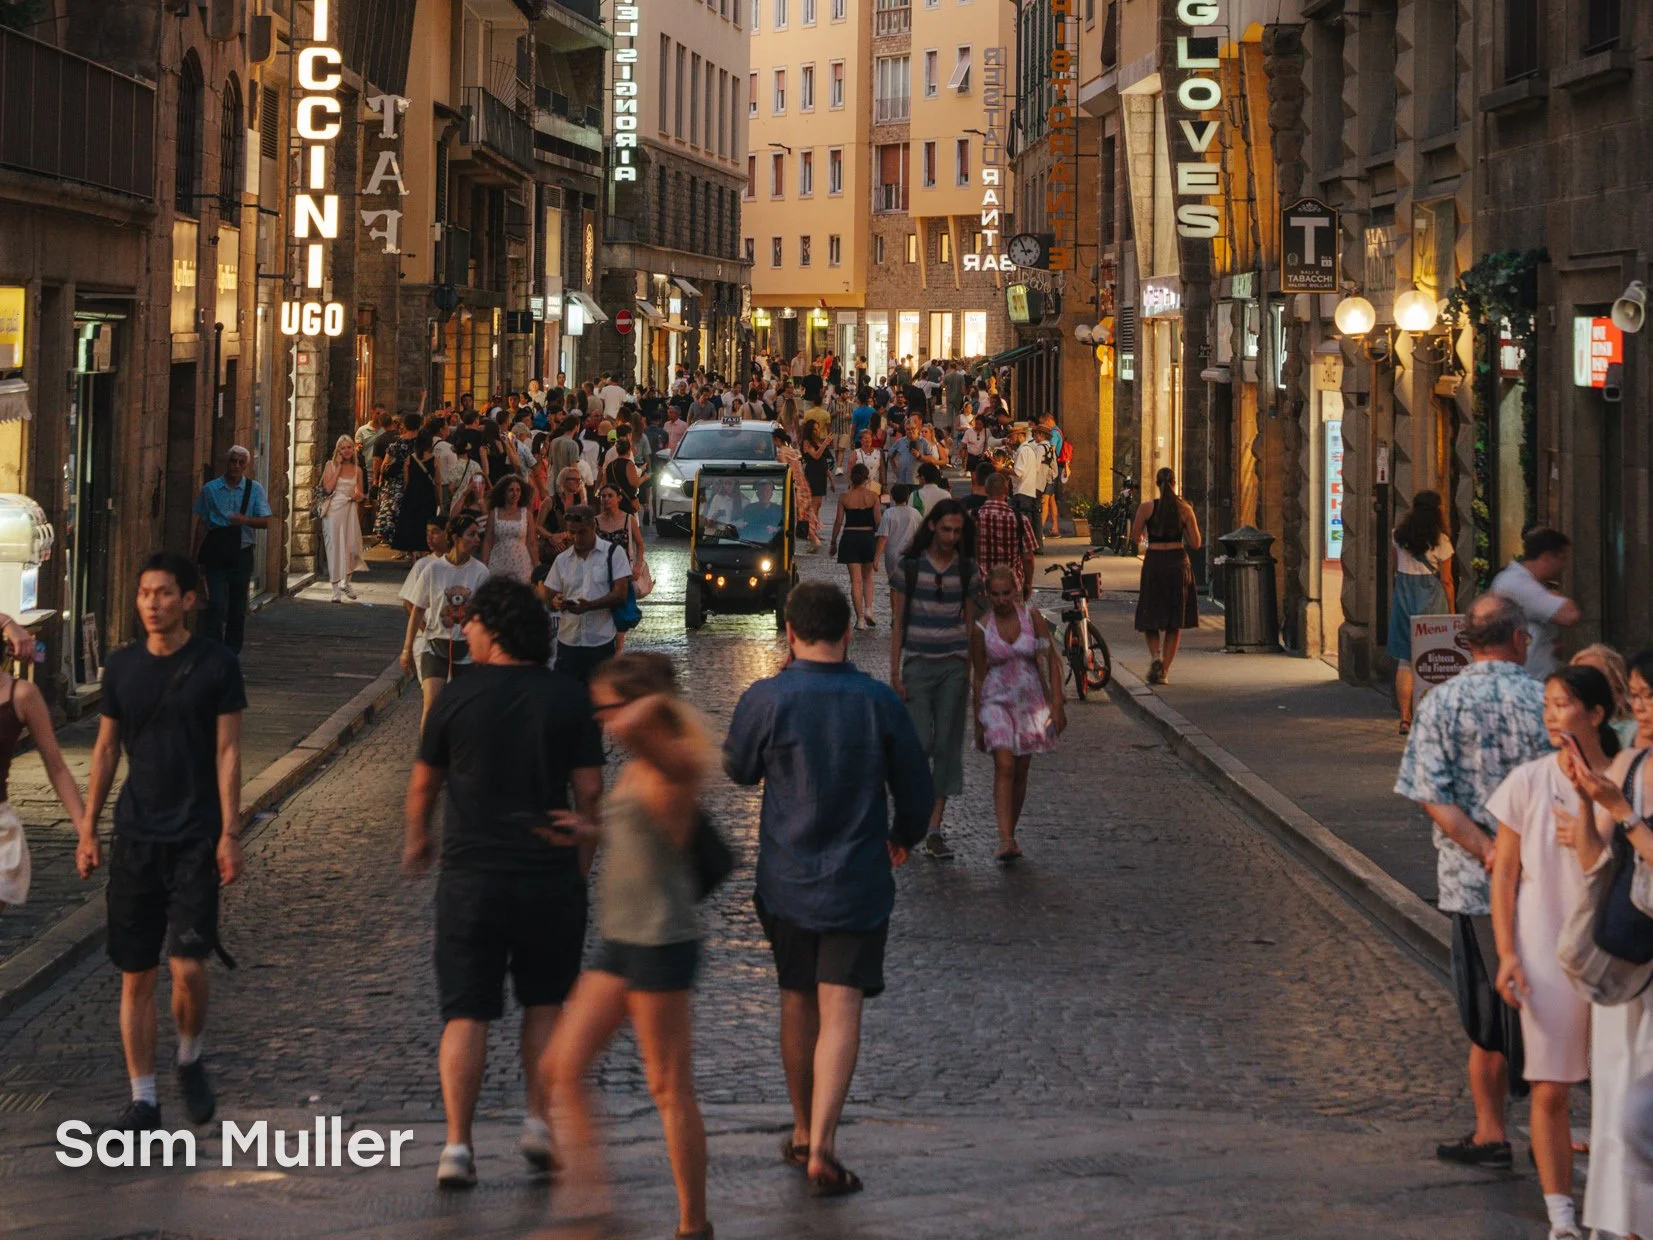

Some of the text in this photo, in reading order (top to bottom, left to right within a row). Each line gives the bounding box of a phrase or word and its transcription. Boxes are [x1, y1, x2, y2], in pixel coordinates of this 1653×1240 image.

[1290, 217, 1329, 264] T
[1288, 275, 1332, 283] TABACCHI
[280, 302, 344, 337] UGO
[1415, 623, 1448, 637] Menu
